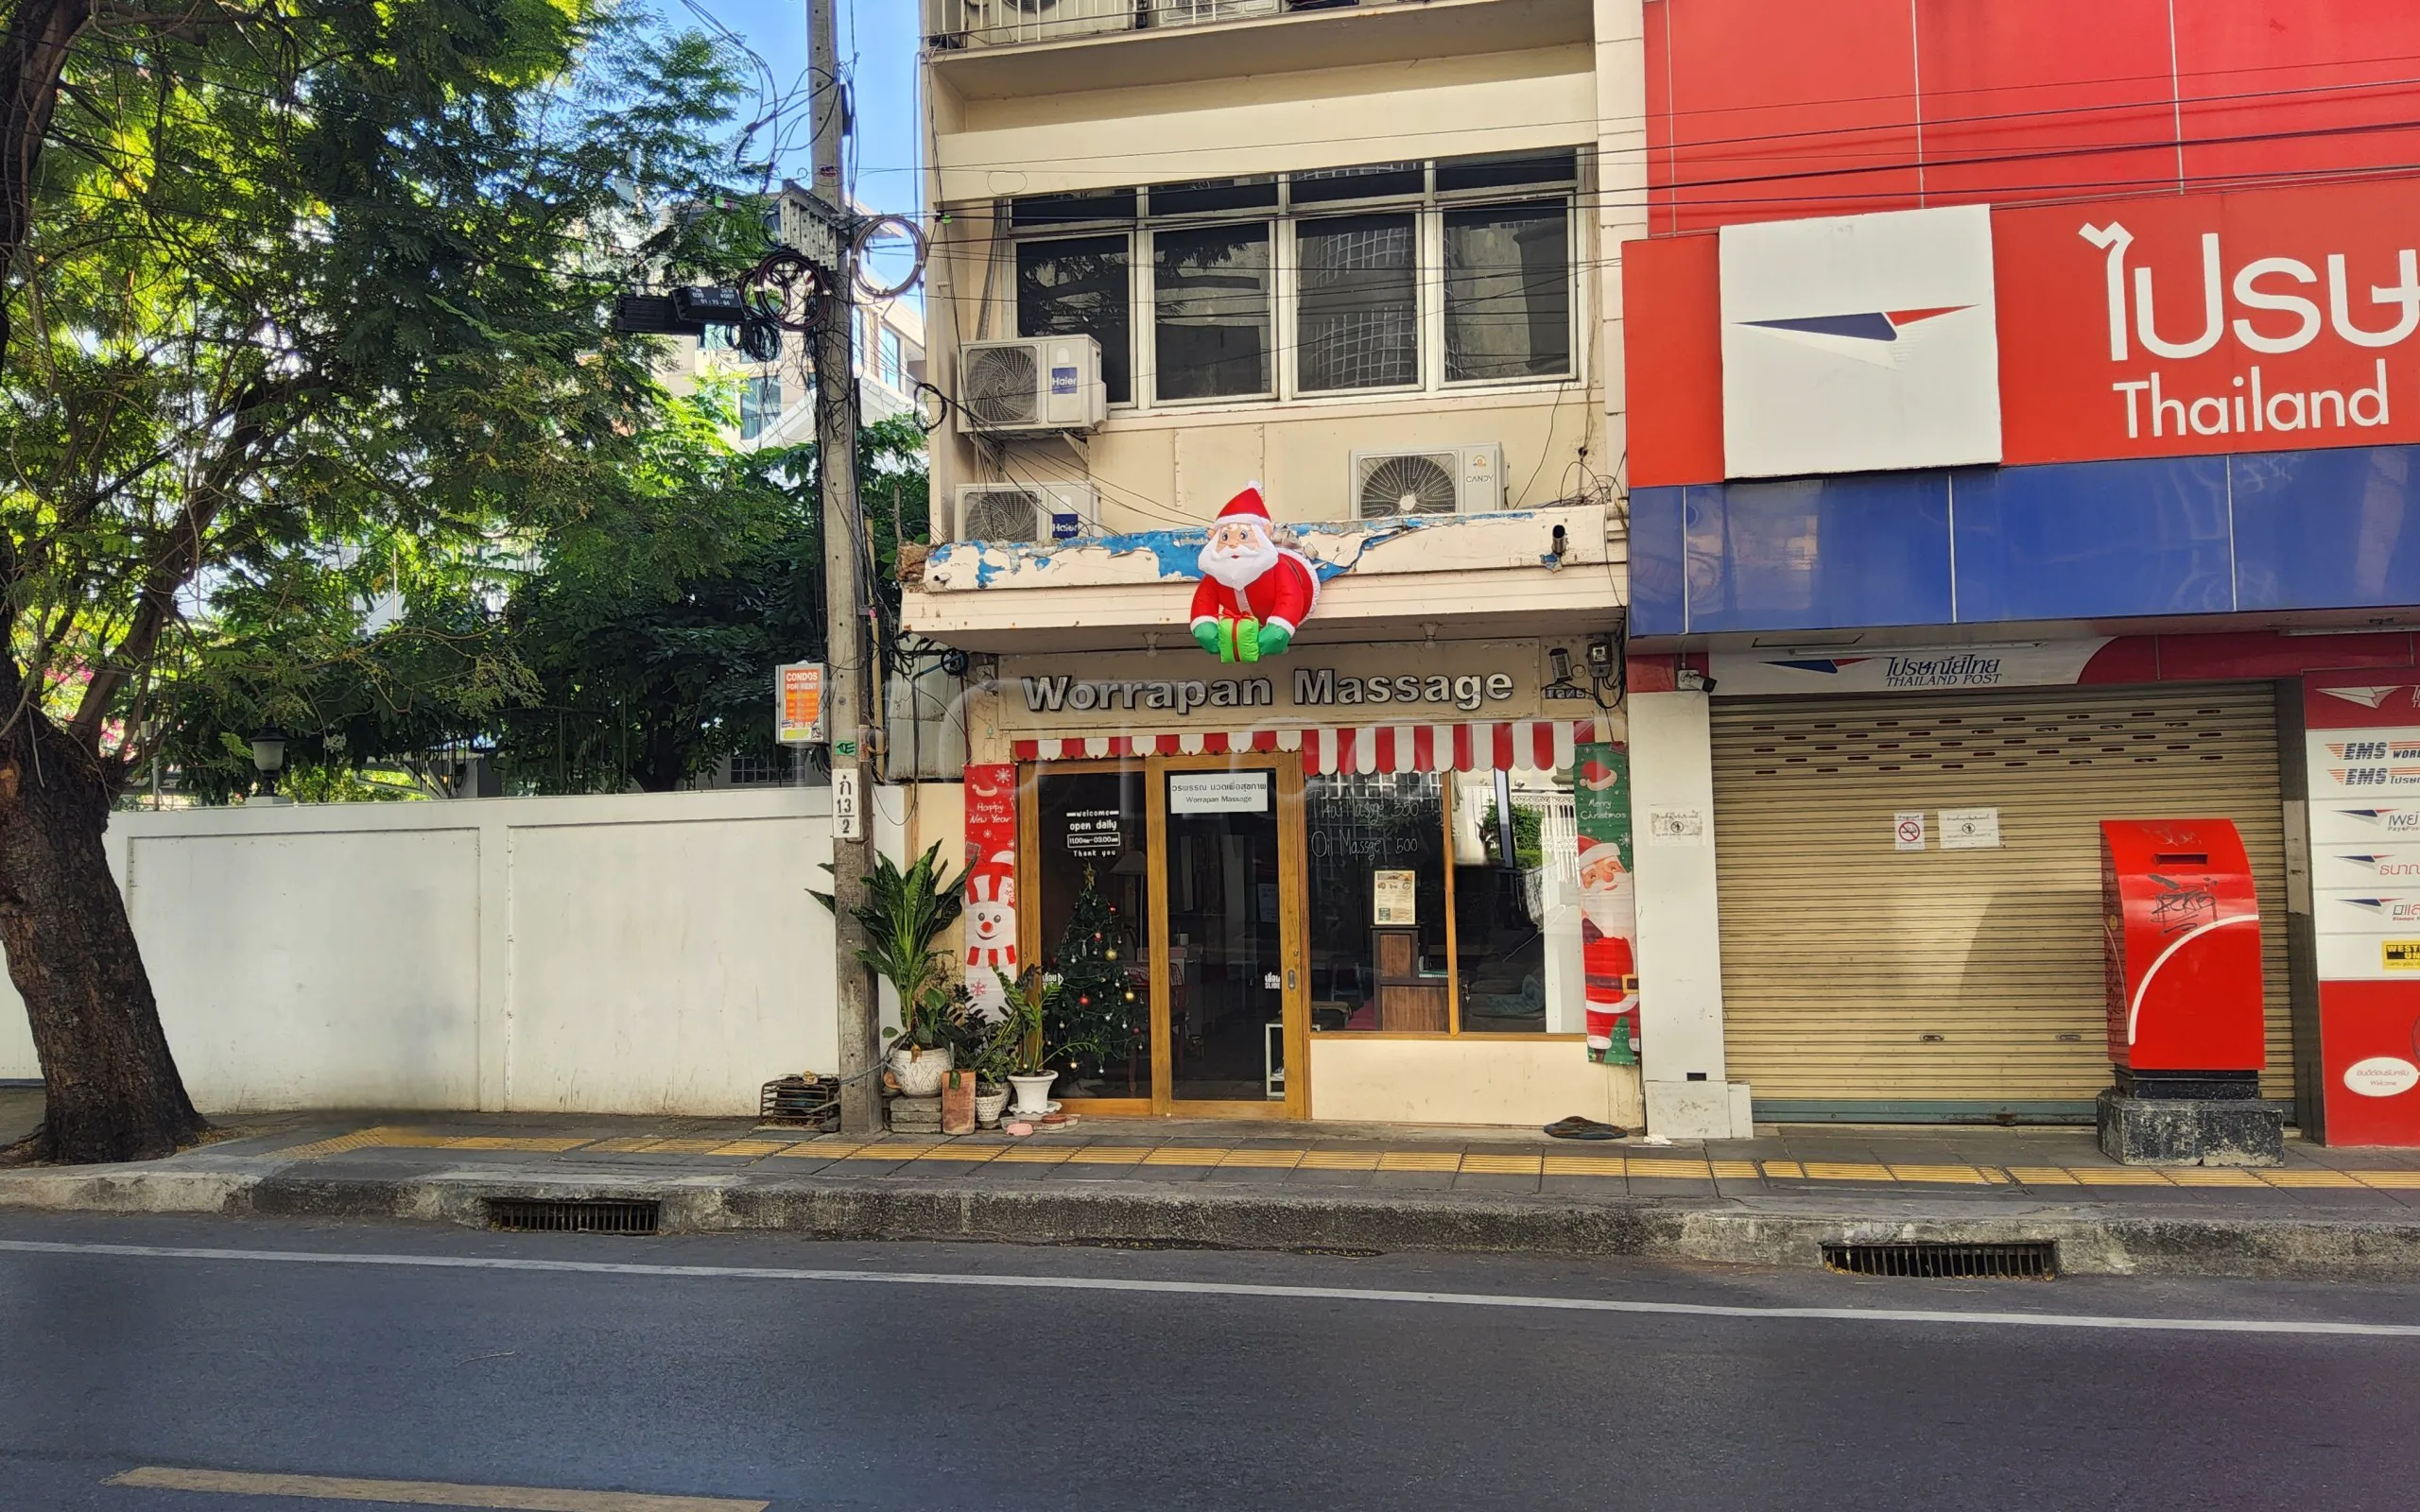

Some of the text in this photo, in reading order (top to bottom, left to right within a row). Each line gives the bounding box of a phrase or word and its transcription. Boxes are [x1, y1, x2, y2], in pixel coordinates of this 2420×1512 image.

[1052, 377, 1077, 387] Haier
[2113, 358, 2390, 438] Thailand
[1465, 474, 1494, 483] CANDY
[1053, 523, 1078, 532] Haier
[1886, 654, 2001, 677] ไปรษณีย์ไทย
[786, 671, 818, 681] CONDOS
[1887, 674, 2002, 687] THAILAND POST
[1021, 668, 1513, 715] Worrapan Massage
[2343, 742, 2387, 760] EMS
[2345, 768, 2388, 785] EMS
[1220, 795, 1253, 803] Massage
[1588, 799, 1612, 809] Merry
[837, 799, 852, 814] 13
[977, 802, 1004, 814] Happy
[1392, 801, 1419, 816] 350
[970, 814, 1011, 823] New Year
[1580, 810, 1627, 820] Christmas
[842, 819, 850, 833] 2
[1069, 819, 1117, 832] open daily
[1311, 831, 1334, 857] Oil
[1394, 838, 1418, 854] 500
